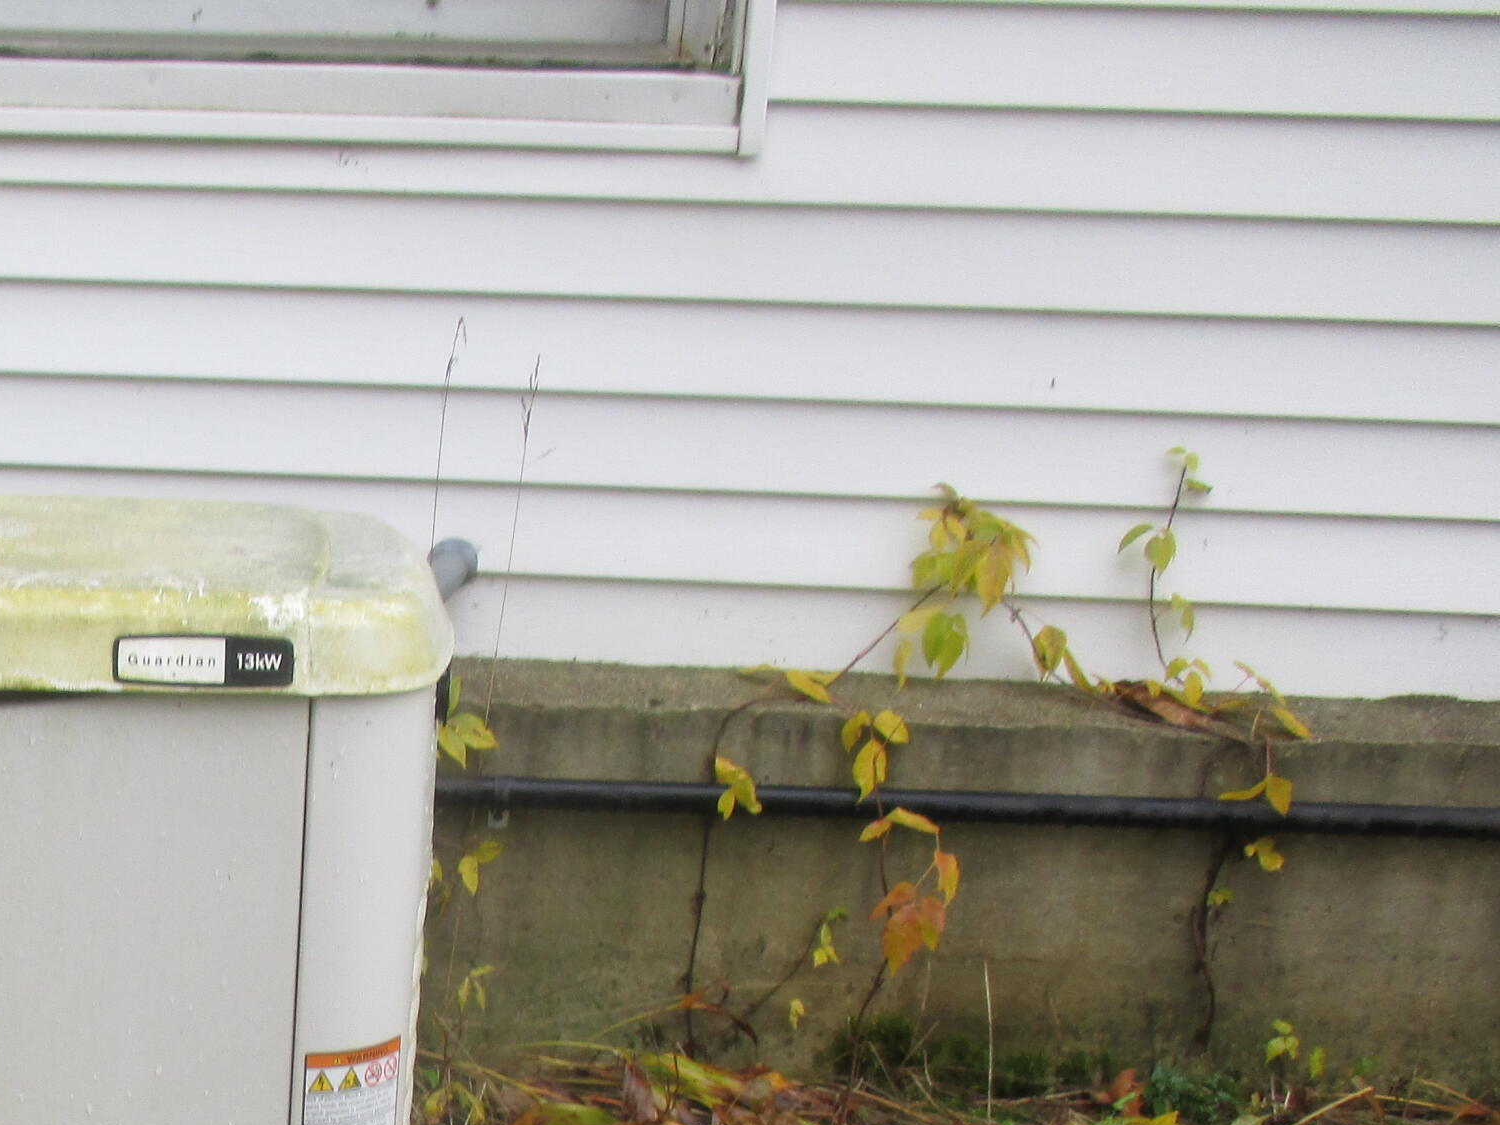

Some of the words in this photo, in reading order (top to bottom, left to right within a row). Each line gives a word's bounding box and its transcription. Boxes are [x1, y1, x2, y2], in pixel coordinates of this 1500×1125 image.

[127, 652, 217, 669] Guardian
[236, 652, 283, 671] 13kW
[347, 1045, 389, 1064] WARNING
